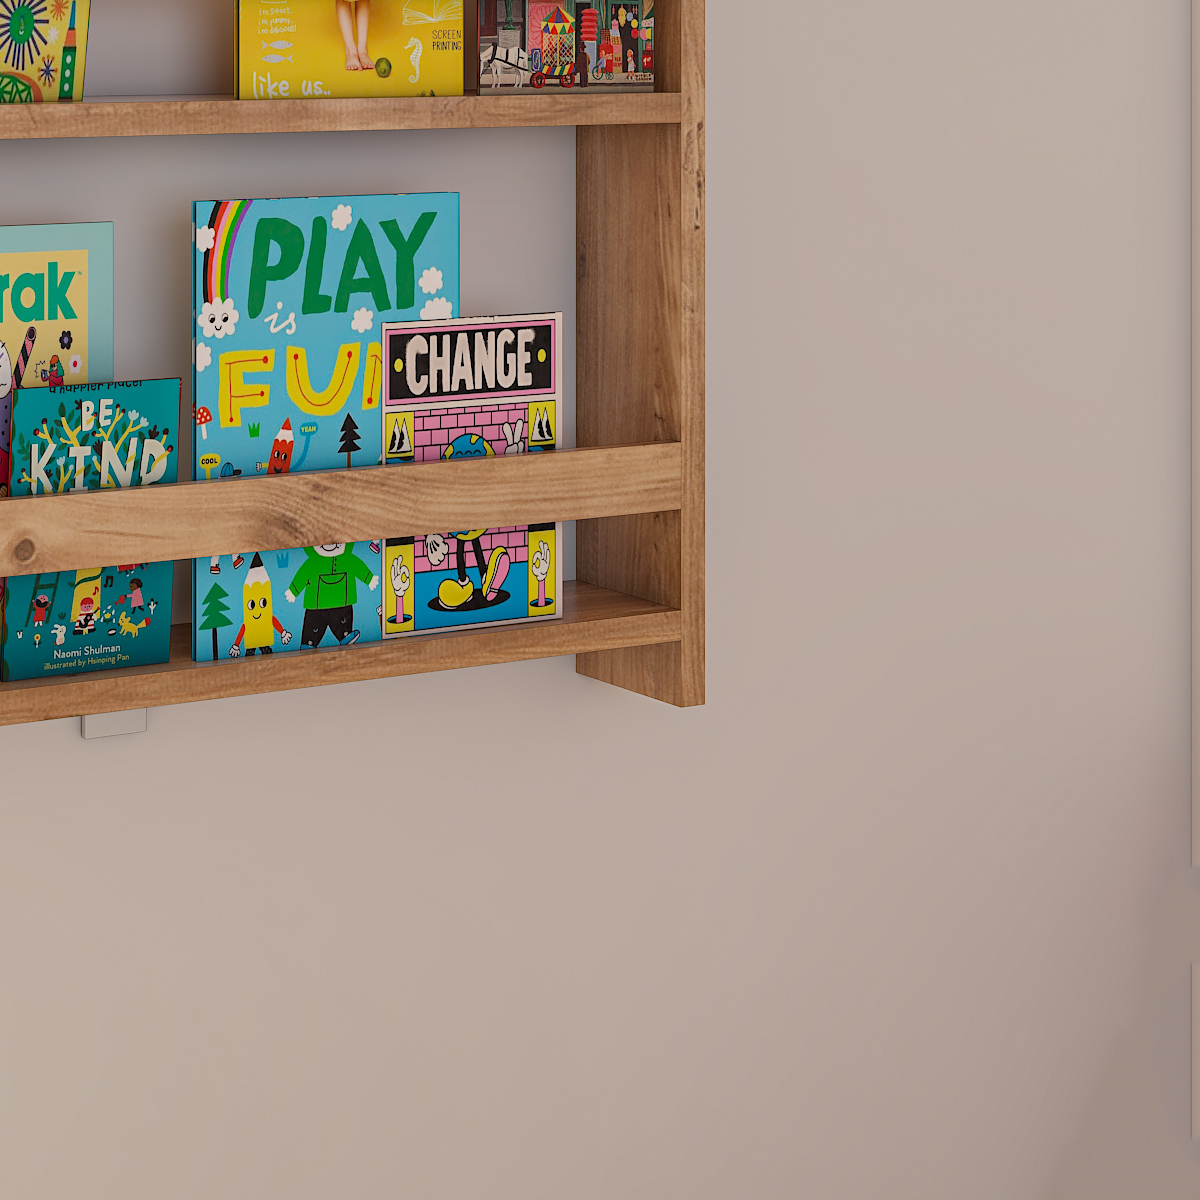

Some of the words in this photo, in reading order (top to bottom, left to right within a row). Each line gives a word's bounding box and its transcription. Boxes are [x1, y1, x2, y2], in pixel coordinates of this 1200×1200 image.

[432, 29, 461, 40] SCREEN
[432, 40, 462, 51] PRINTING
[252, 71, 290, 99] like
[248, 211, 437, 319] PLAY
[264, 301, 296, 335] is
[405, 328, 535, 395] CHANGE
[81, 399, 113, 431] BE
[30, 437, 168, 495] KIND
[44, 659, 76, 670] illustrated
[78, 659, 86, 668] by
[117, 653, 129, 661] Pan
[53, 647, 82, 659] Naomi
[84, 644, 120, 656] Shulman
